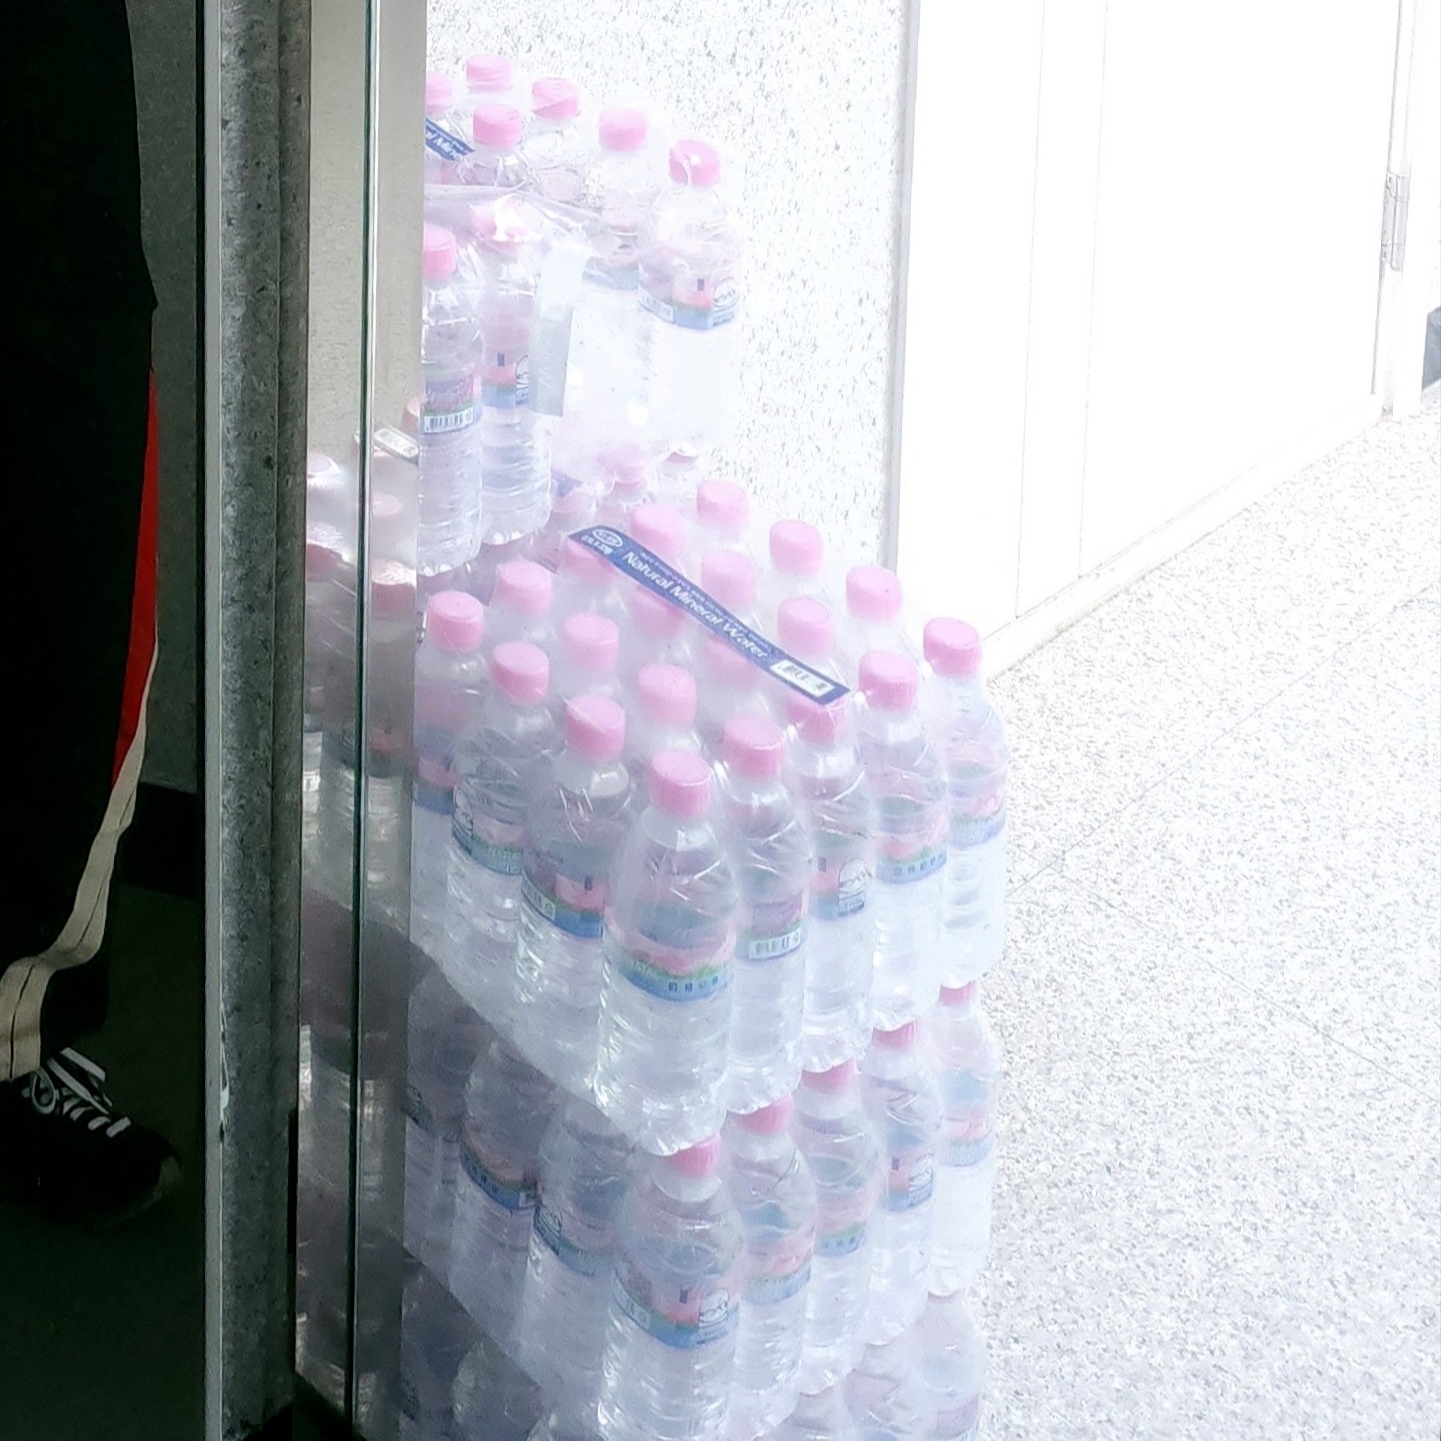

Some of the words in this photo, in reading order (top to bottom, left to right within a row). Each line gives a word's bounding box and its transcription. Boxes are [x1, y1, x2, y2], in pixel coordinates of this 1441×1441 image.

[622, 551, 675, 589] Natural
[669, 585, 723, 625] Mineral
[722, 622, 768, 658] Water
